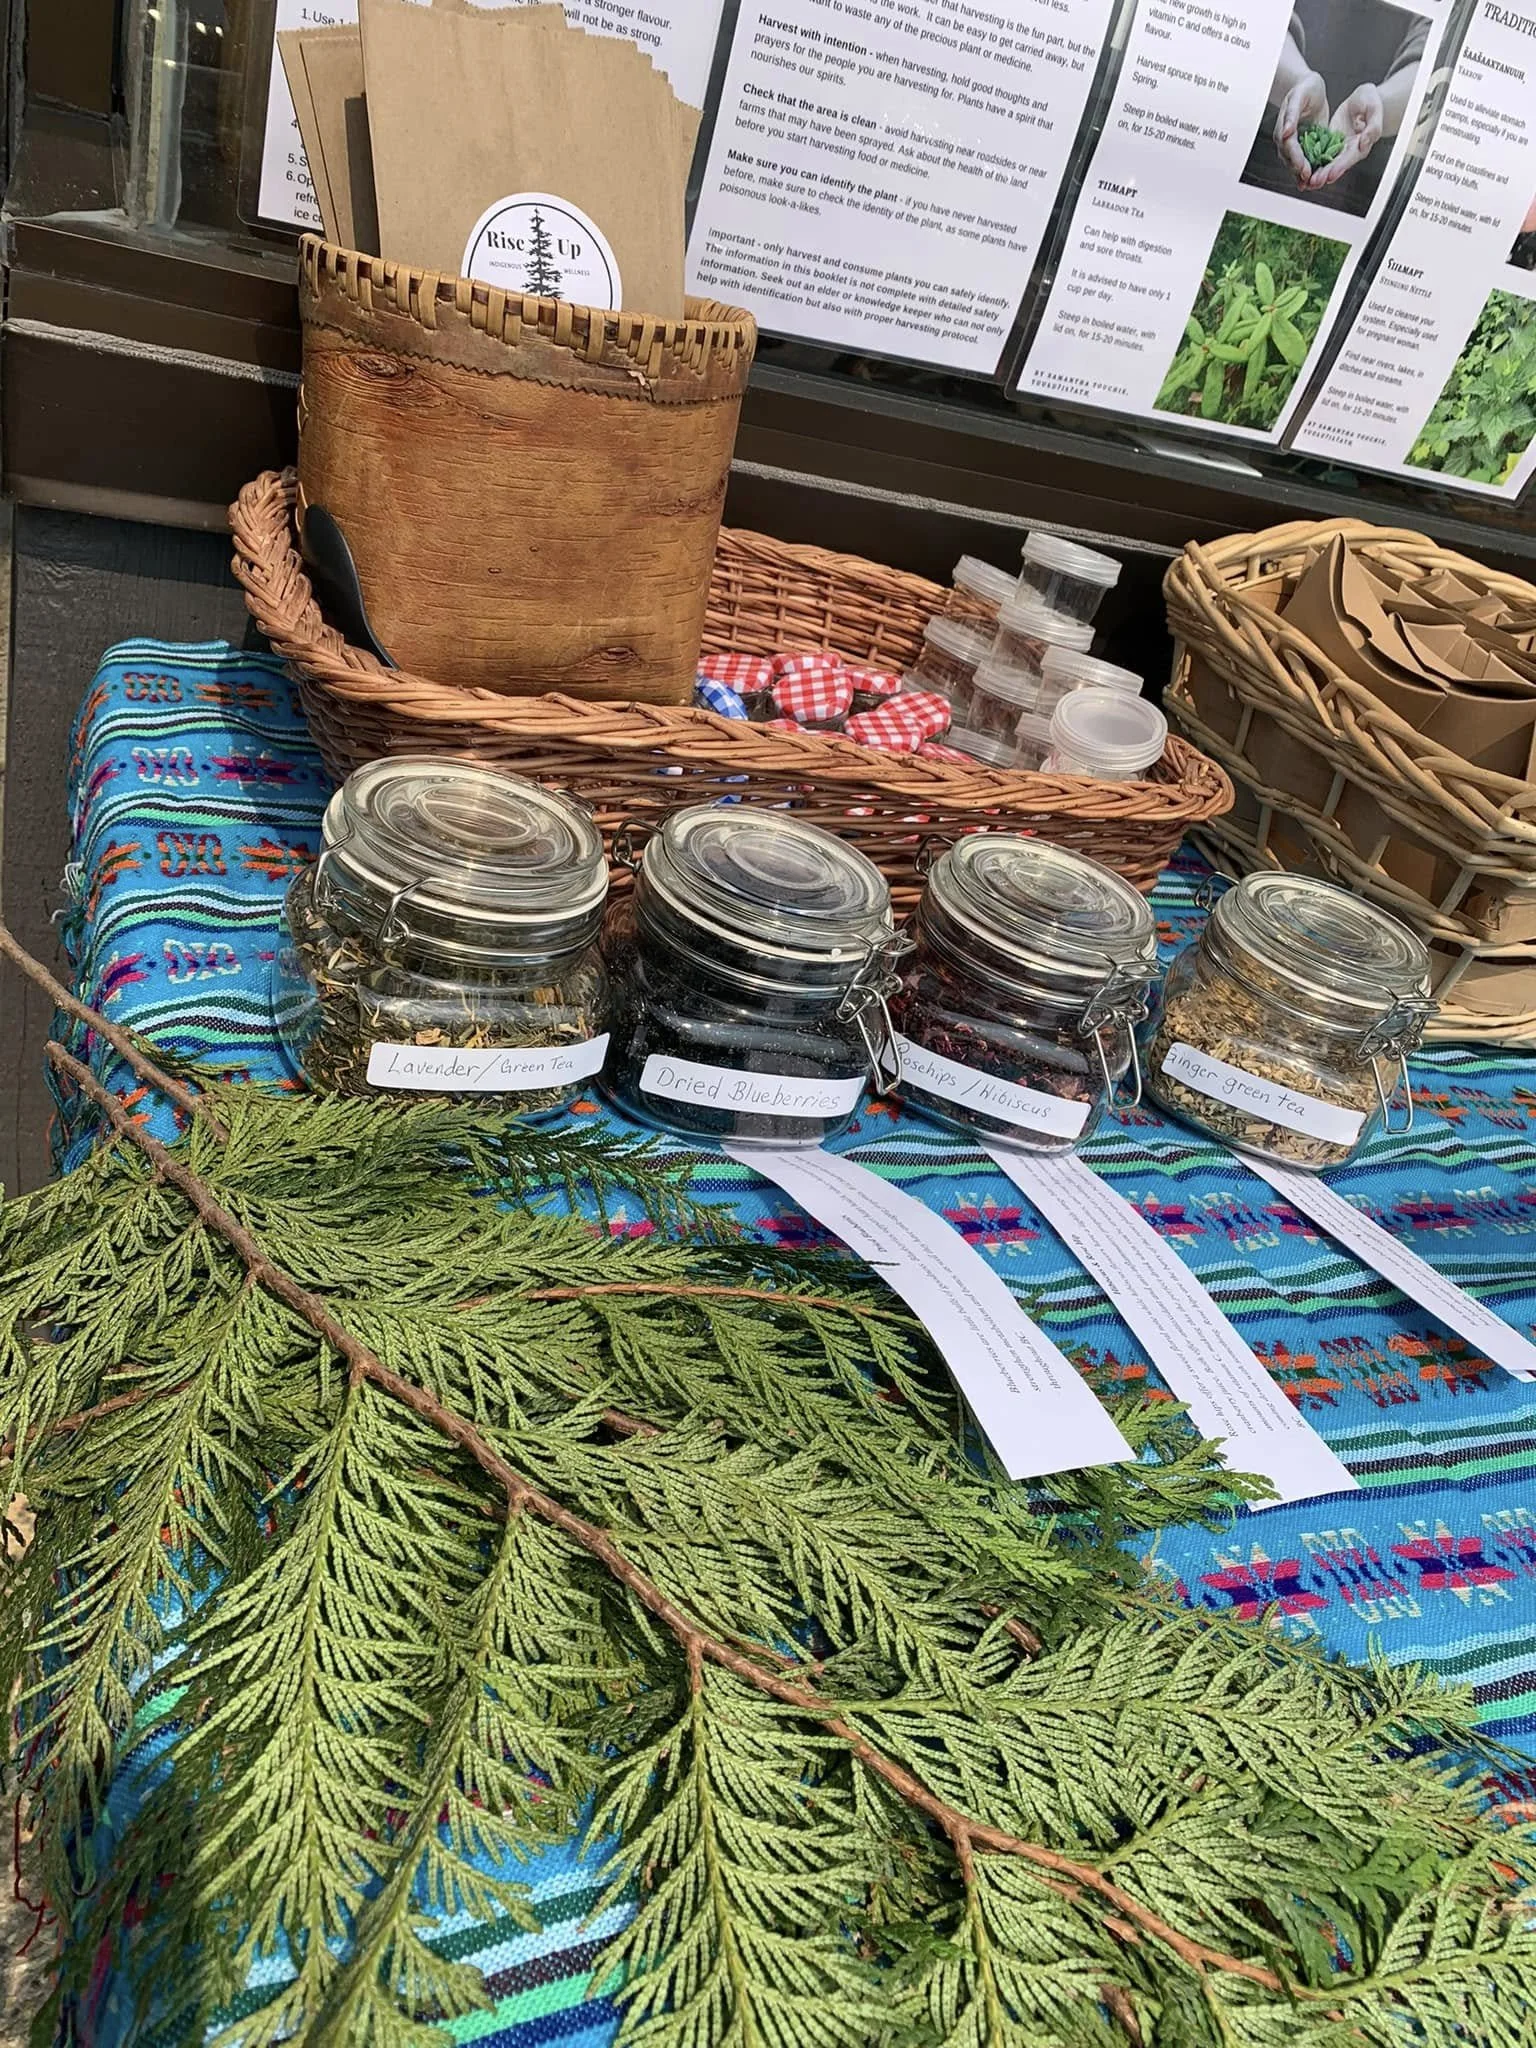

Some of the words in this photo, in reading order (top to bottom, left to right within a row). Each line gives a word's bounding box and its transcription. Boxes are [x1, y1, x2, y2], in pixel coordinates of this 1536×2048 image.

[561, 4, 581, 22] will
[581, 13, 599, 27] not
[600, 16, 614, 32] be
[615, 23, 629, 36] as
[629, 27, 663, 47] strong.
[593, 0, 635, 19] stronger
[636, 8, 672, 31] flavour.
[1148, 7, 1177, 25] vitamin
[1176, 15, 1186, 28] C
[1184, 19, 1202, 33] and
[1200, 25, 1224, 41] offers
[1222, 32, 1230, 43] a
[749, 48, 798, 72] nourishes
[798, 63, 815, 77] our
[815, 69, 847, 89] spirits.
[757, 12, 799, 36] Harvest
[799, 26, 822, 43] with
[822, 31, 868, 57] intention
[875, 50, 900, 67] when
[900, 56, 949, 84] harvesting,
[950, 72, 972, 89] hold
[970, 80, 994, 96] good
[993, 86, 1031, 107] thoughts
[1030, 99, 1049, 112] and
[1130, 69, 1159, 90] Spring.
[1135, 54, 1167, 74] Harvest
[1166, 65, 1193, 83] spruce
[1192, 73, 1208, 87] tips
[1207, 77, 1217, 90] in
[1215, 80, 1230, 94] the
[742, 82, 775, 101] Check
[776, 91, 797, 108] that
[797, 98, 815, 113] the
[815, 104, 838, 120] area
[839, 109, 850, 123] is
[850, 113, 877, 131] clean
[883, 124, 910, 139] avoid
[954, 144, 976, 158] near
[975, 151, 1018, 171] roadsides
[1017, 163, 1028, 173] or
[1027, 165, 1048, 179] near
[1121, 101, 1146, 120] Steep
[1145, 108, 1155, 121] in
[1153, 111, 1180, 128] boiled
[1178, 119, 1201, 137] water,
[1201, 127, 1218, 140] with
[1217, 130, 1229, 143] lid
[734, 114, 766, 134] before
[765, 125, 785, 139] you
[785, 131, 808, 146] start
[808, 135, 856, 161] harvesting
[856, 148, 879, 165] food
[877, 157, 889, 167] or
[889, 160, 930, 180] medicine.
[718, 181, 768, 202] poisonous
[767, 192, 822, 217] look-a-likes.
[726, 147, 754, 165] Make
[755, 157, 778, 172] sure
[778, 163, 799, 177] you
[799, 169, 818, 182] can
[819, 172, 856, 194] identify
[856, 183, 873, 197] the
[872, 188, 899, 204] plant
[904, 194, 913, 207] if
[910, 199, 929, 212] you
[928, 201, 951, 217] have
[951, 209, 976, 224] never
[975, 215, 1018, 235] harvested
[294, 206, 310, 220] ice
[487, 230, 525, 251] Rise
[557, 239, 581, 260] Up
[1078, 240, 1096, 252] and
[1095, 244, 1114, 257] sore
[1114, 247, 1143, 264] throats.
[1083, 223, 1101, 238] Can
[1100, 228, 1120, 244] help
[1119, 234, 1137, 248] with
[1136, 239, 1173, 257] digestion
[707, 226, 756, 248] Important
[762, 241, 785, 257] only
[785, 245, 822, 264] harvest
[822, 256, 842, 268] and
[841, 261, 884, 279] consume
[883, 271, 913, 286] plants
[912, 278, 932, 290] you
[931, 283, 949, 294] can
[949, 287, 977, 302] safely
[976, 291, 1010, 310] identify.
[695, 270, 718, 286] help
[719, 277, 741, 290] with
[741, 280, 804, 305] identification
[804, 295, 822, 309] but
[821, 300, 842, 313] also
[843, 305, 863, 318] with
[862, 311, 895, 325] proper
[894, 316, 941, 338] harvesting
[940, 328, 979, 345] protocol.
[550, 1055, 574, 1070] Tea
[656, 1066, 722, 1098] Dried
[727, 1079, 841, 1111] Blueberries
[1222, 1076, 1270, 1104] green
[1277, 1092, 1306, 1117] tea
[983, 1346, 1021, 1394] Blueberries
